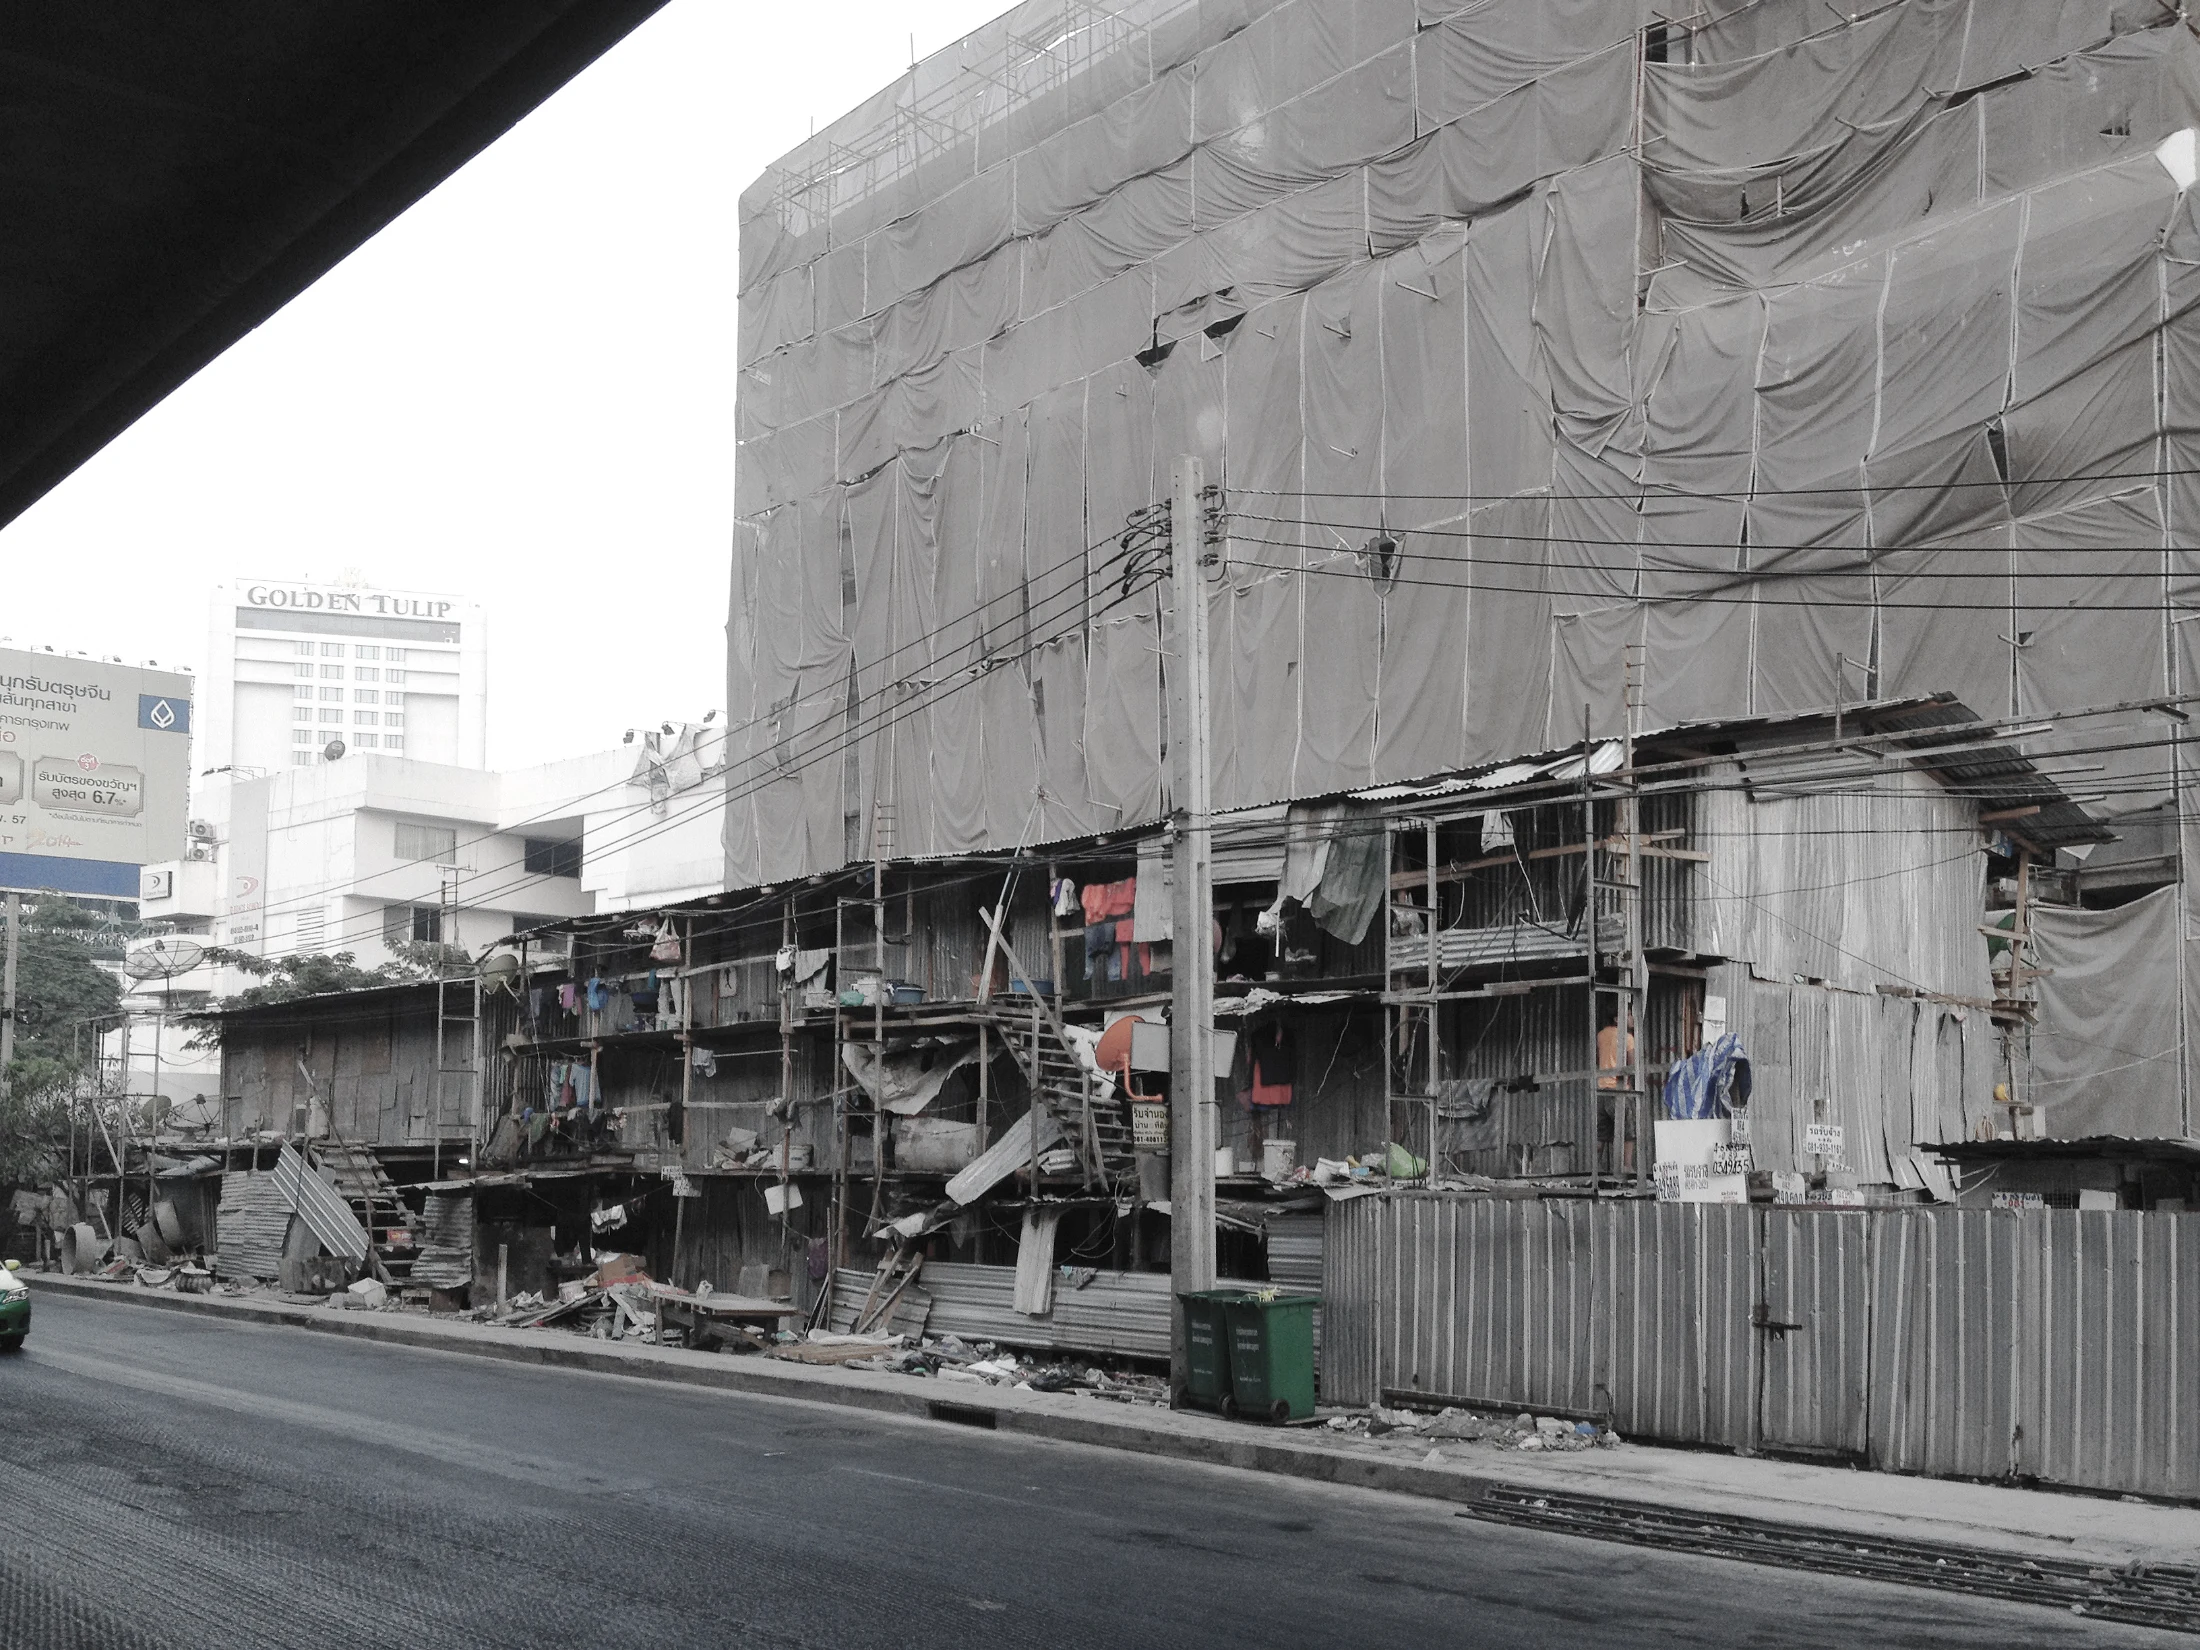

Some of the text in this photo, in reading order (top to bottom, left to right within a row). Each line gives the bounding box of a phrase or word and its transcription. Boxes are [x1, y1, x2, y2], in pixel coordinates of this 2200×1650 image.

[247, 586, 451, 618] GOLDEN TULIP
[52, 788, 86, 801] สูงสุด
[12, 815, 27, 824] 57
